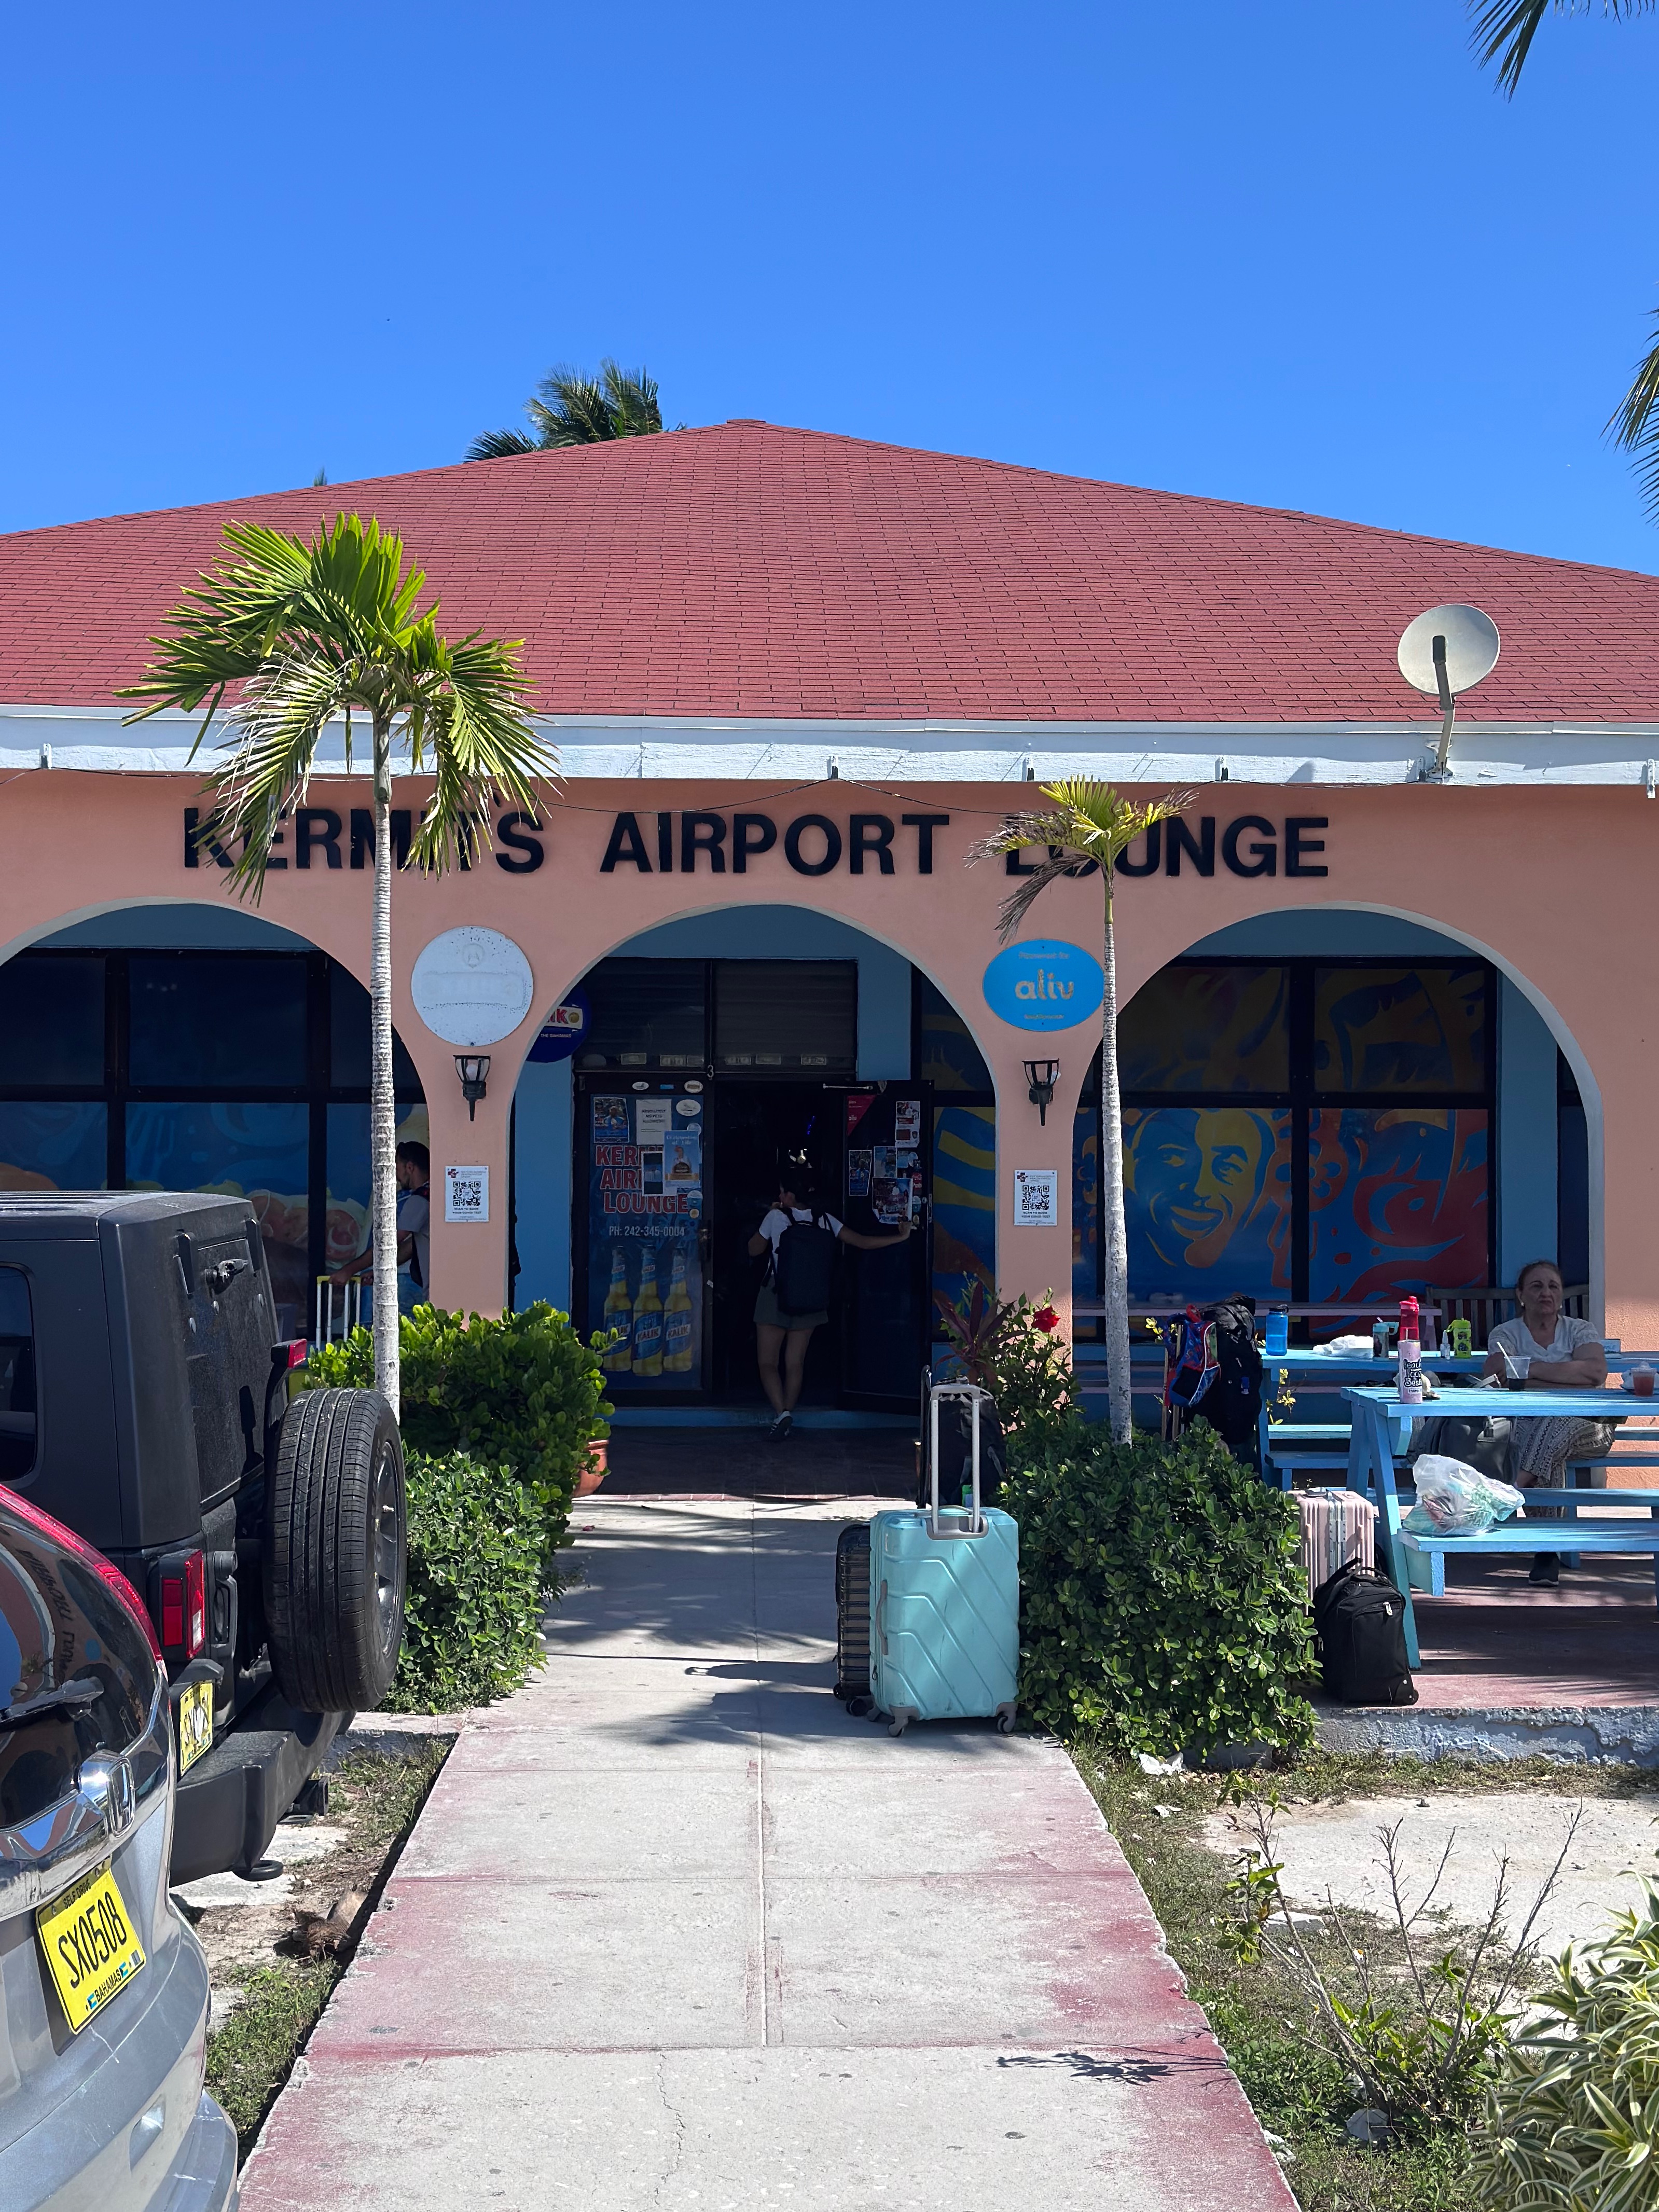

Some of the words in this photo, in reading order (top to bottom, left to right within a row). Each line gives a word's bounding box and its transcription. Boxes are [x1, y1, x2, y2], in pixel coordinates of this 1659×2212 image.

[600, 812, 950, 876] AIRPORT
[1015, 969, 1074, 1000] aliv
[600, 1168, 642, 1190] AIR
[603, 1192, 689, 1214] LOUNGE
[609, 1226, 623, 1237] PH:
[624, 1225, 685, 1237] 242-345-0004
[637, 1328, 660, 1343] KALIK
[668, 1324, 689, 1339] KALIK
[63, 1892, 77, 1910] SELF
[58, 1891, 127, 1989] SX0508
[95, 1969, 122, 2002] BAHAMAS
